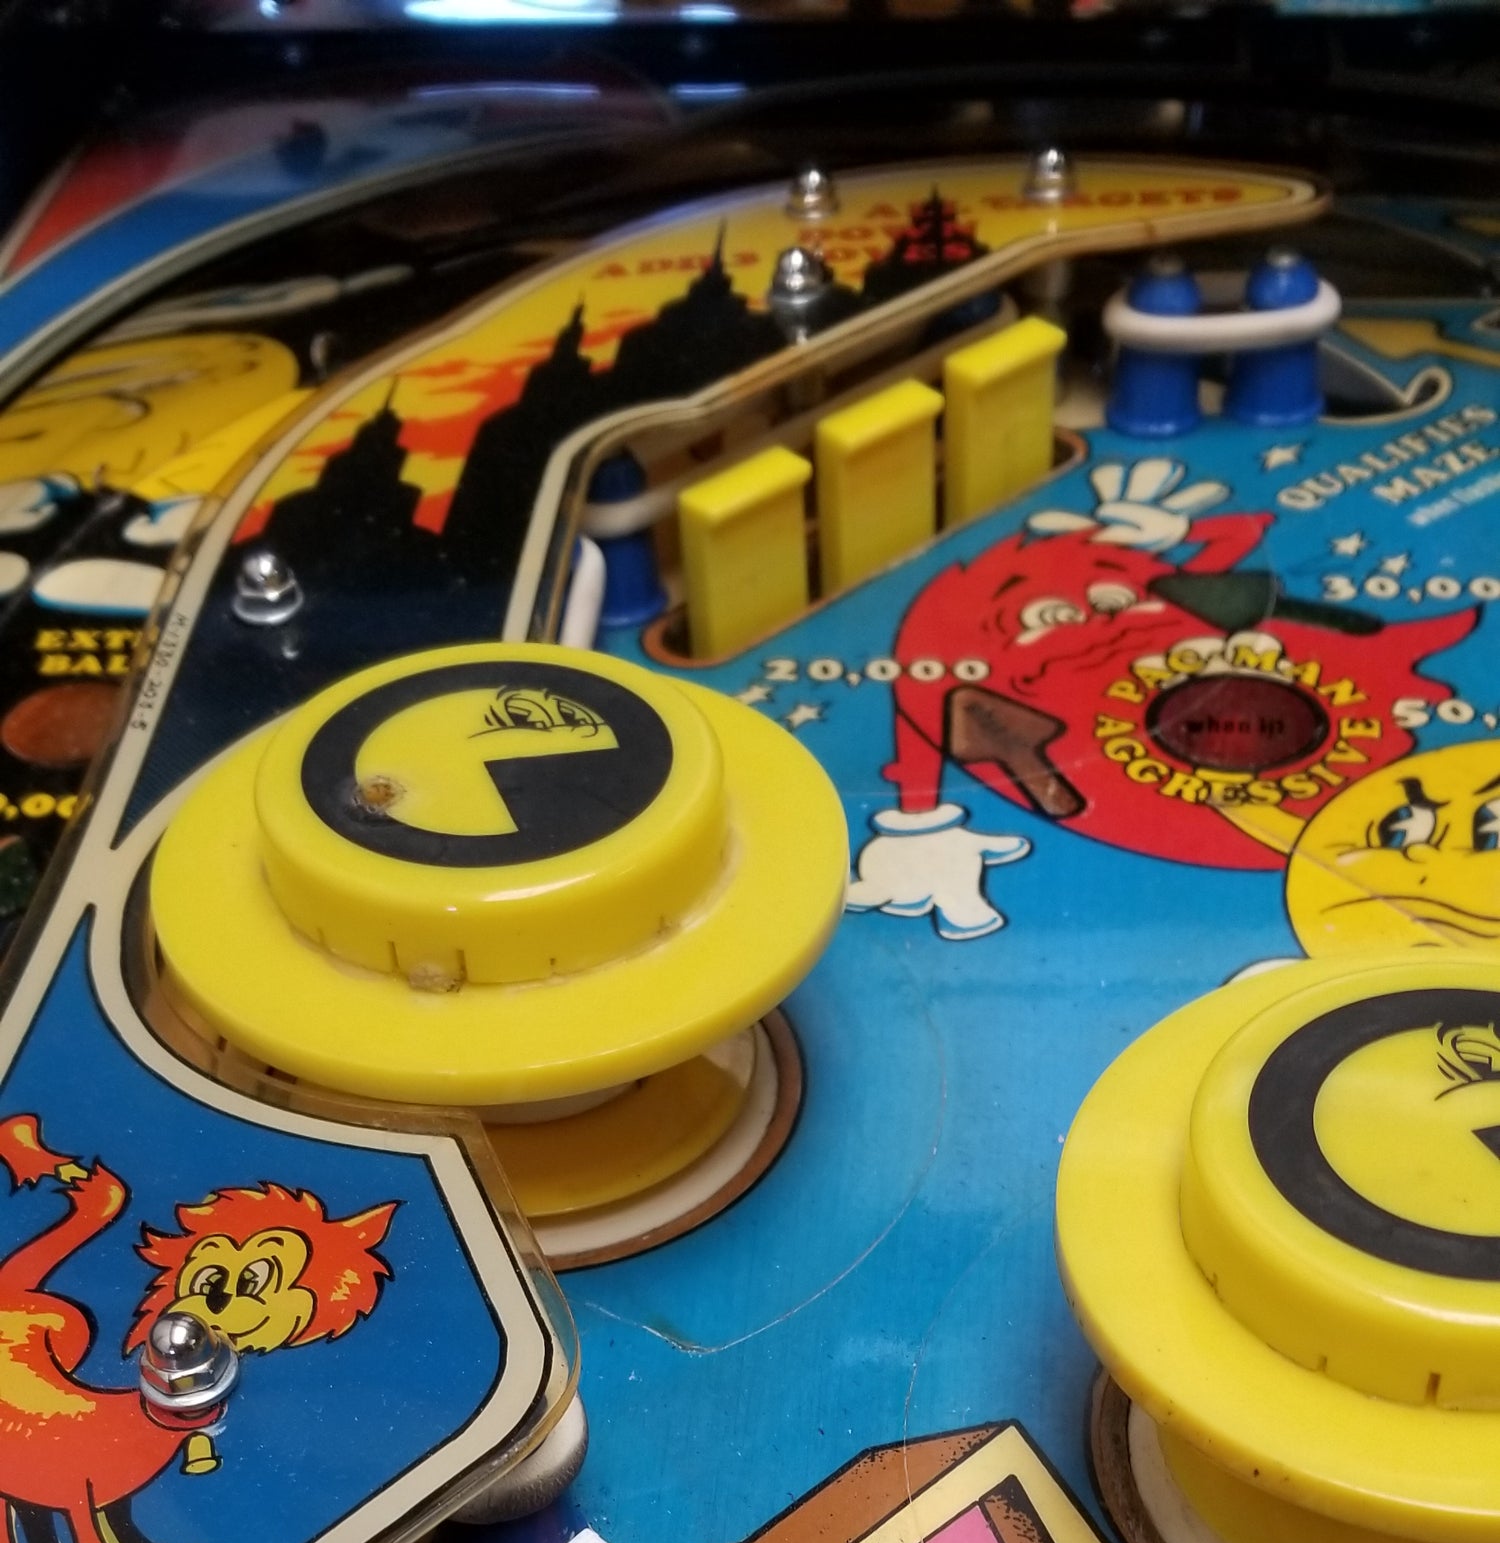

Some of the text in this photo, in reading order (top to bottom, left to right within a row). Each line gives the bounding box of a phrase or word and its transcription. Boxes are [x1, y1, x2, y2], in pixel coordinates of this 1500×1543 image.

[41, 653, 132, 675] BAL
[763, 658, 990, 687] 20,000
[1095, 714, 1382, 806] AGGRESSIVE
